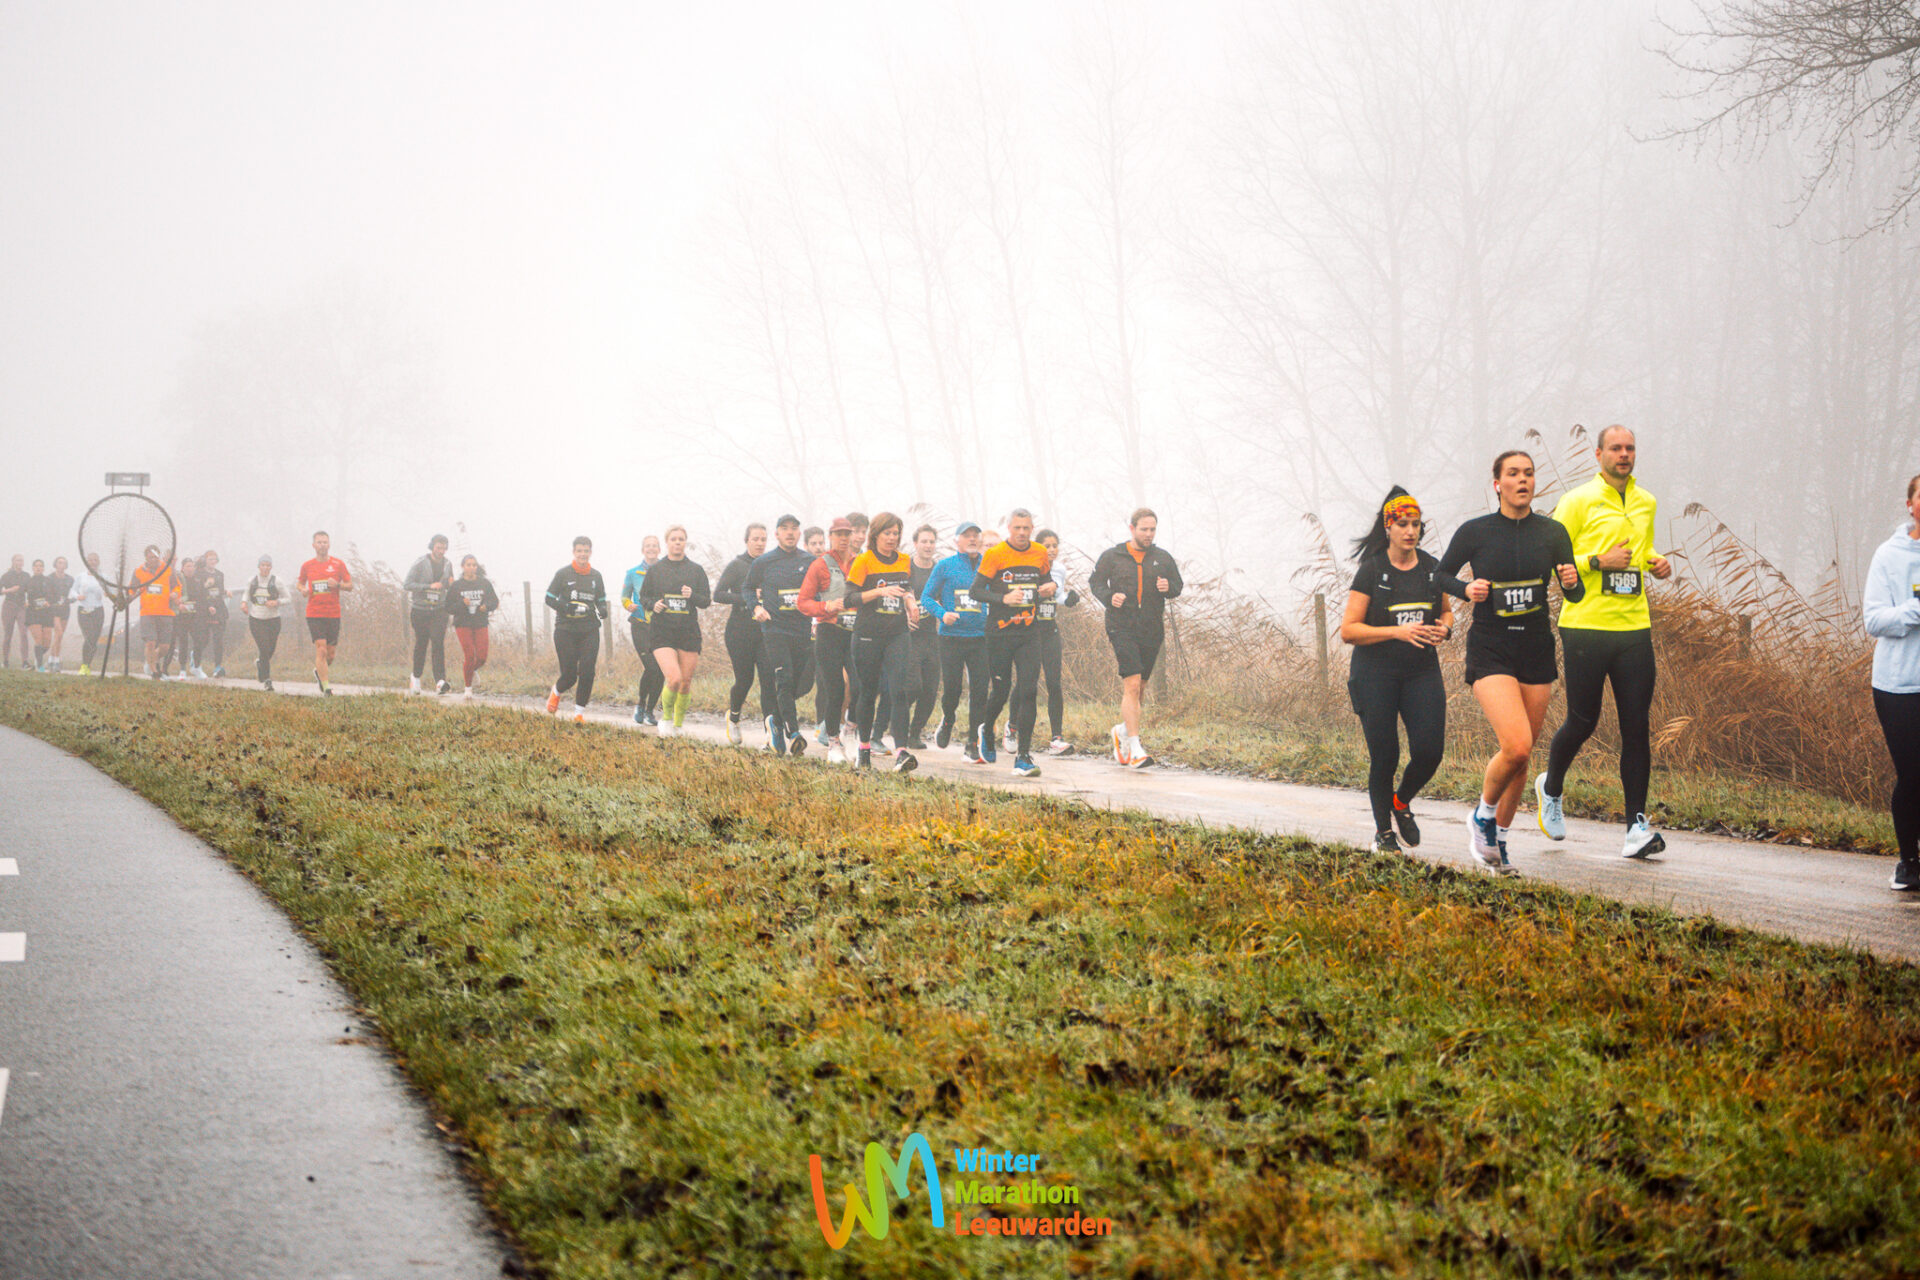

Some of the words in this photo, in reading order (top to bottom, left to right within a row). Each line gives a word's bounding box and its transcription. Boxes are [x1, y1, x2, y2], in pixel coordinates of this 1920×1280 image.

[1608, 572, 1638, 588] 1569
[1504, 588, 1533, 605] 1114
[1396, 610, 1425, 626] 1259
